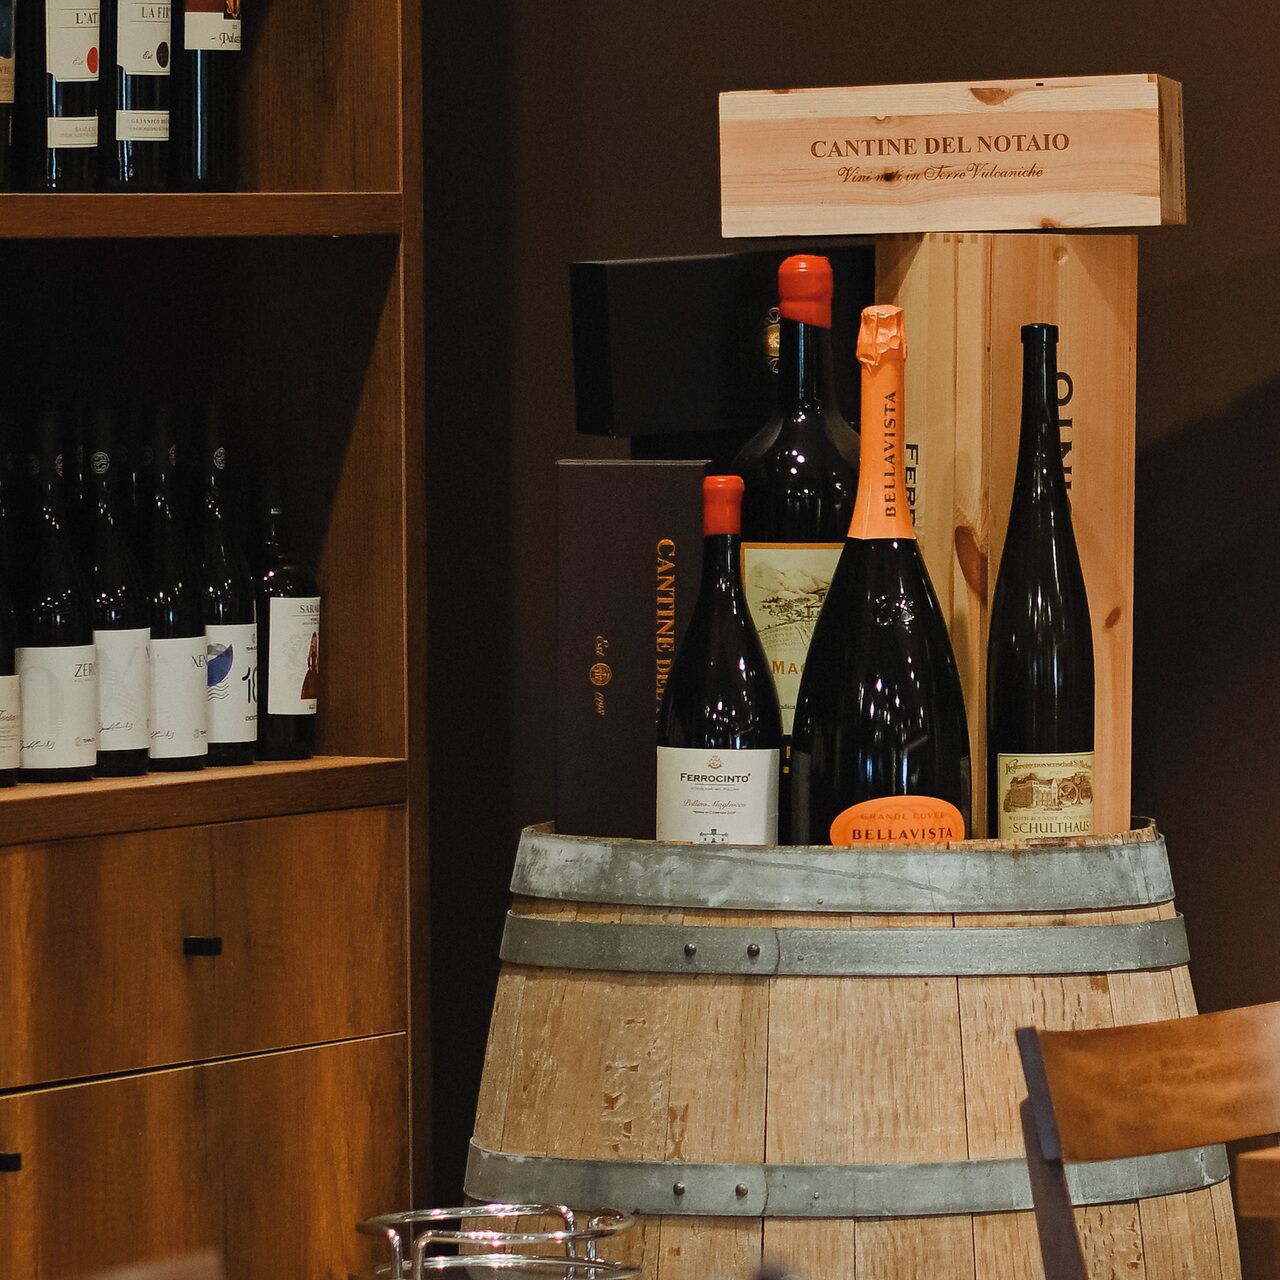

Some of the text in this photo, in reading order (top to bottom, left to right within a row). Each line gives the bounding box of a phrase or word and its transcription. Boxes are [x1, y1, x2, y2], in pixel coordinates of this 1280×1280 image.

[810, 133, 1070, 158] CANTINE DEL NOTAIO
[837, 166, 873, 184] Vini
[966, 162, 1044, 180] Vulcaniche
[883, 391, 897, 518] BELLAVISTA
[656, 538, 677, 652] CANTINE
[680, 772, 749, 783] FERROCINTO
[852, 827, 954, 840] BELLAVISTA
[1012, 821, 1090, 834] SCHULTHAUS
